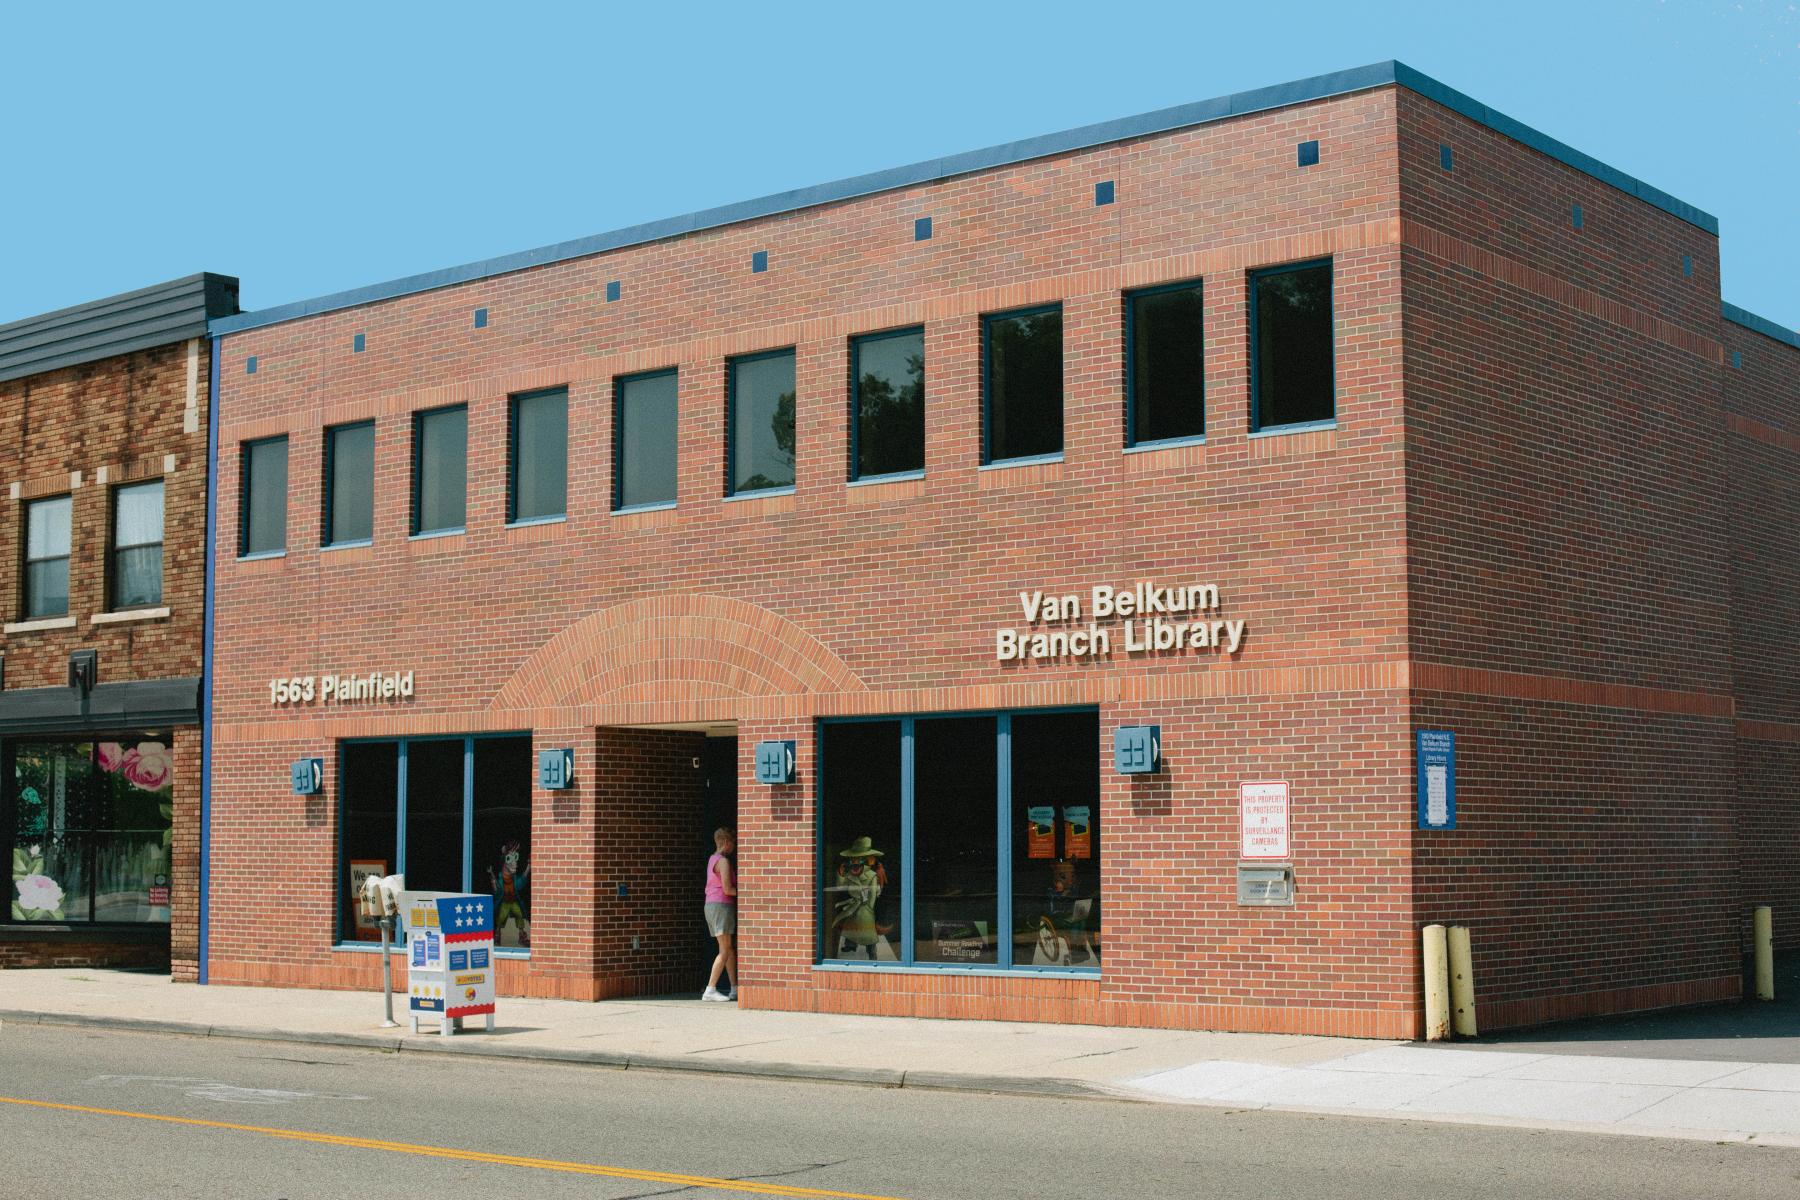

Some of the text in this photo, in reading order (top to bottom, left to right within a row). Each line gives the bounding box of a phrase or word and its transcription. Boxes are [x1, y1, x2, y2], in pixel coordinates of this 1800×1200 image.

[1019, 582, 1219, 622] Van Belkum
[996, 617, 1246, 660] Branch Library
[268, 670, 414, 704] 1563 Plainfield
[1244, 795, 1285, 803] THIS PROPERTY
[1246, 806, 1283, 814] IS PROTECTED
[1260, 816, 1268, 824] BY
[1251, 837, 1279, 845] CAMERAS
[353, 869, 366, 881] We
[942, 946, 980, 959] Challenge
